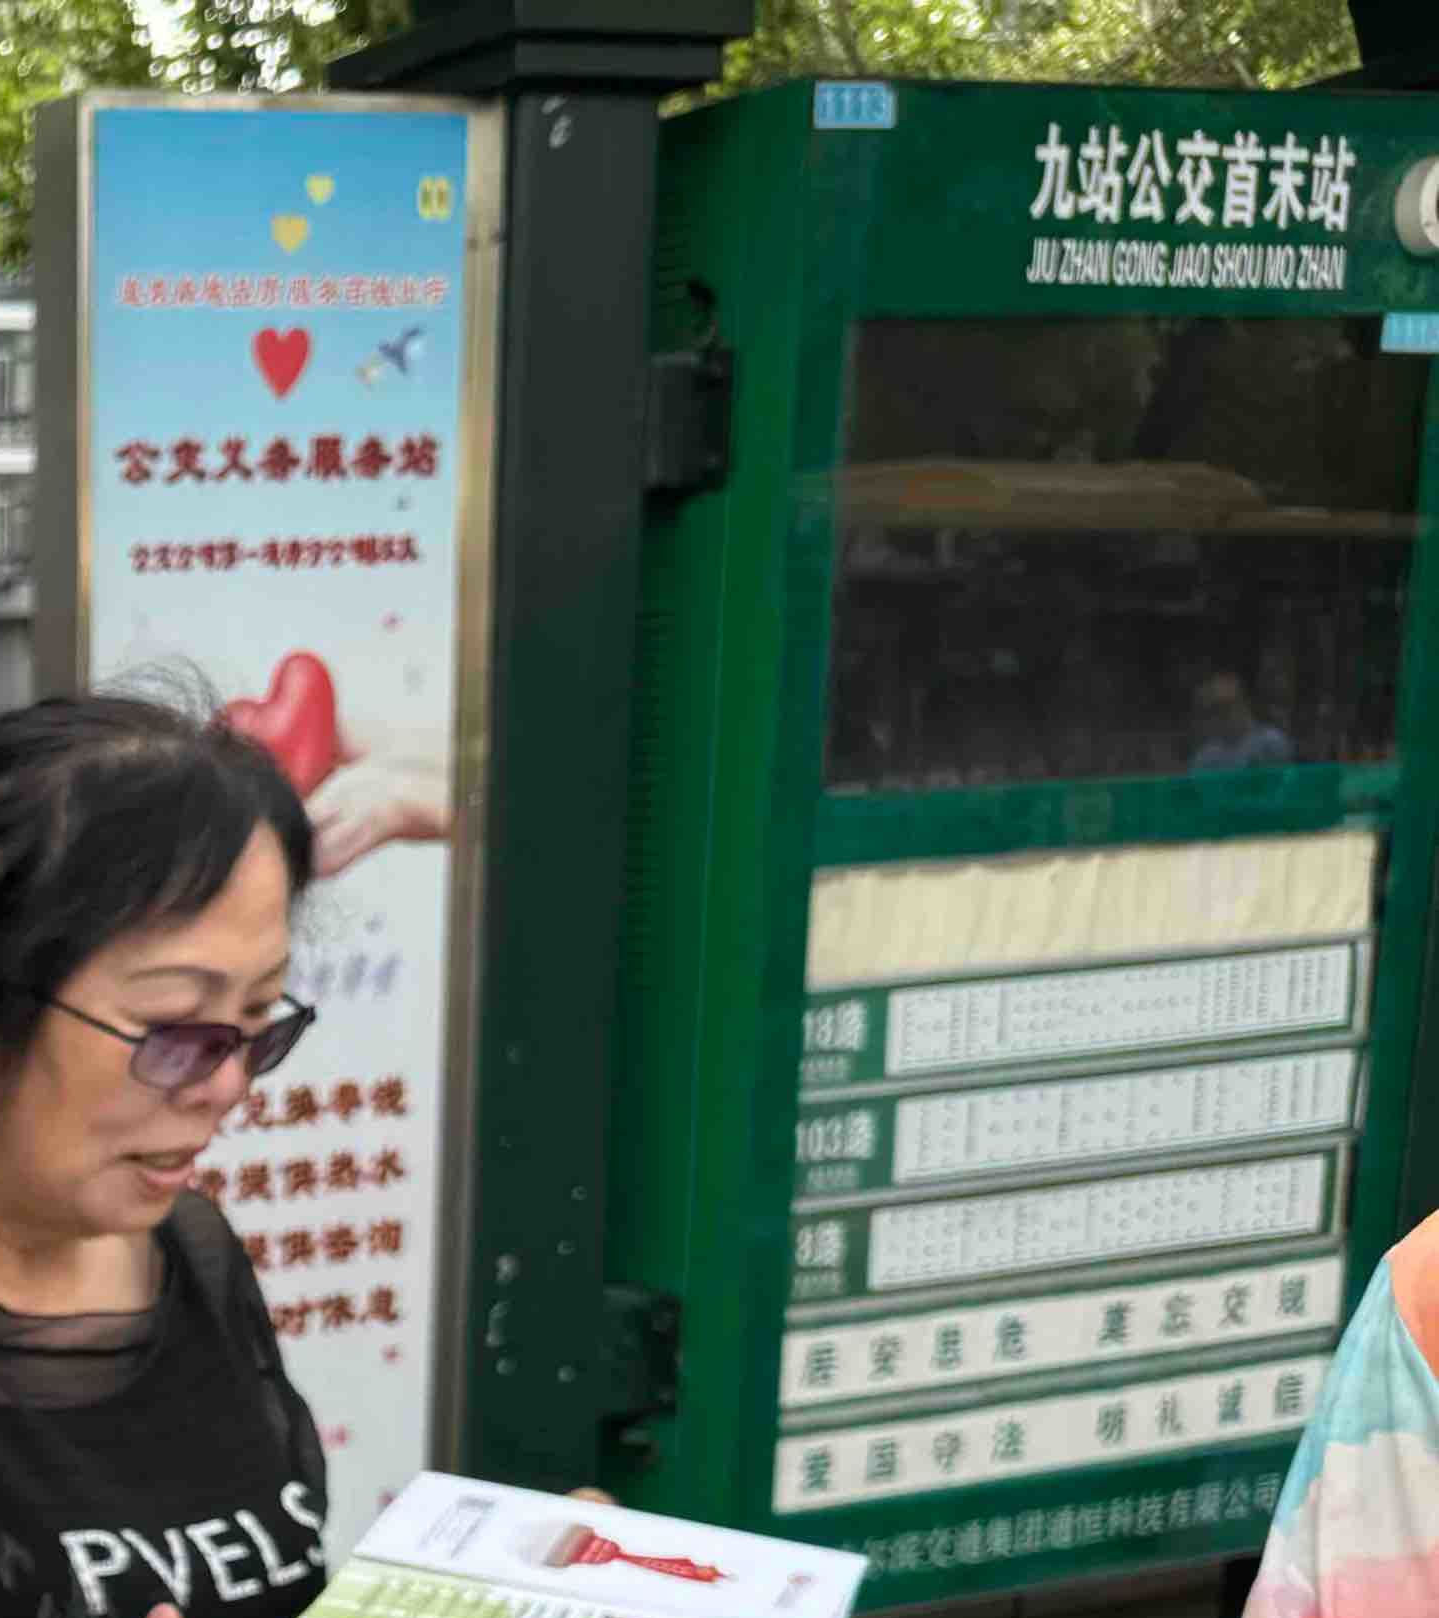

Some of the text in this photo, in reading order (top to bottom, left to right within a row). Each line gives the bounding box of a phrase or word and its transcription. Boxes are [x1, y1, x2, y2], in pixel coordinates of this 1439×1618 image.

[1030, 122, 1355, 232] 九站公交首末站
[1026, 237, 1347, 290] JIU ZHAN GONG JIAO SHOU MO ZHAN
[115, 431, 441, 485] 公交义务服务站
[801, 1311, 1029, 1387] 居安思危
[800, 1372, 1305, 1492] 爱国守法 明礼诚信
[59, 1480, 325, 1616] PVELS
[841, 1473, 1282, 1579] 尔滨交通集团通恒科技有限公司
